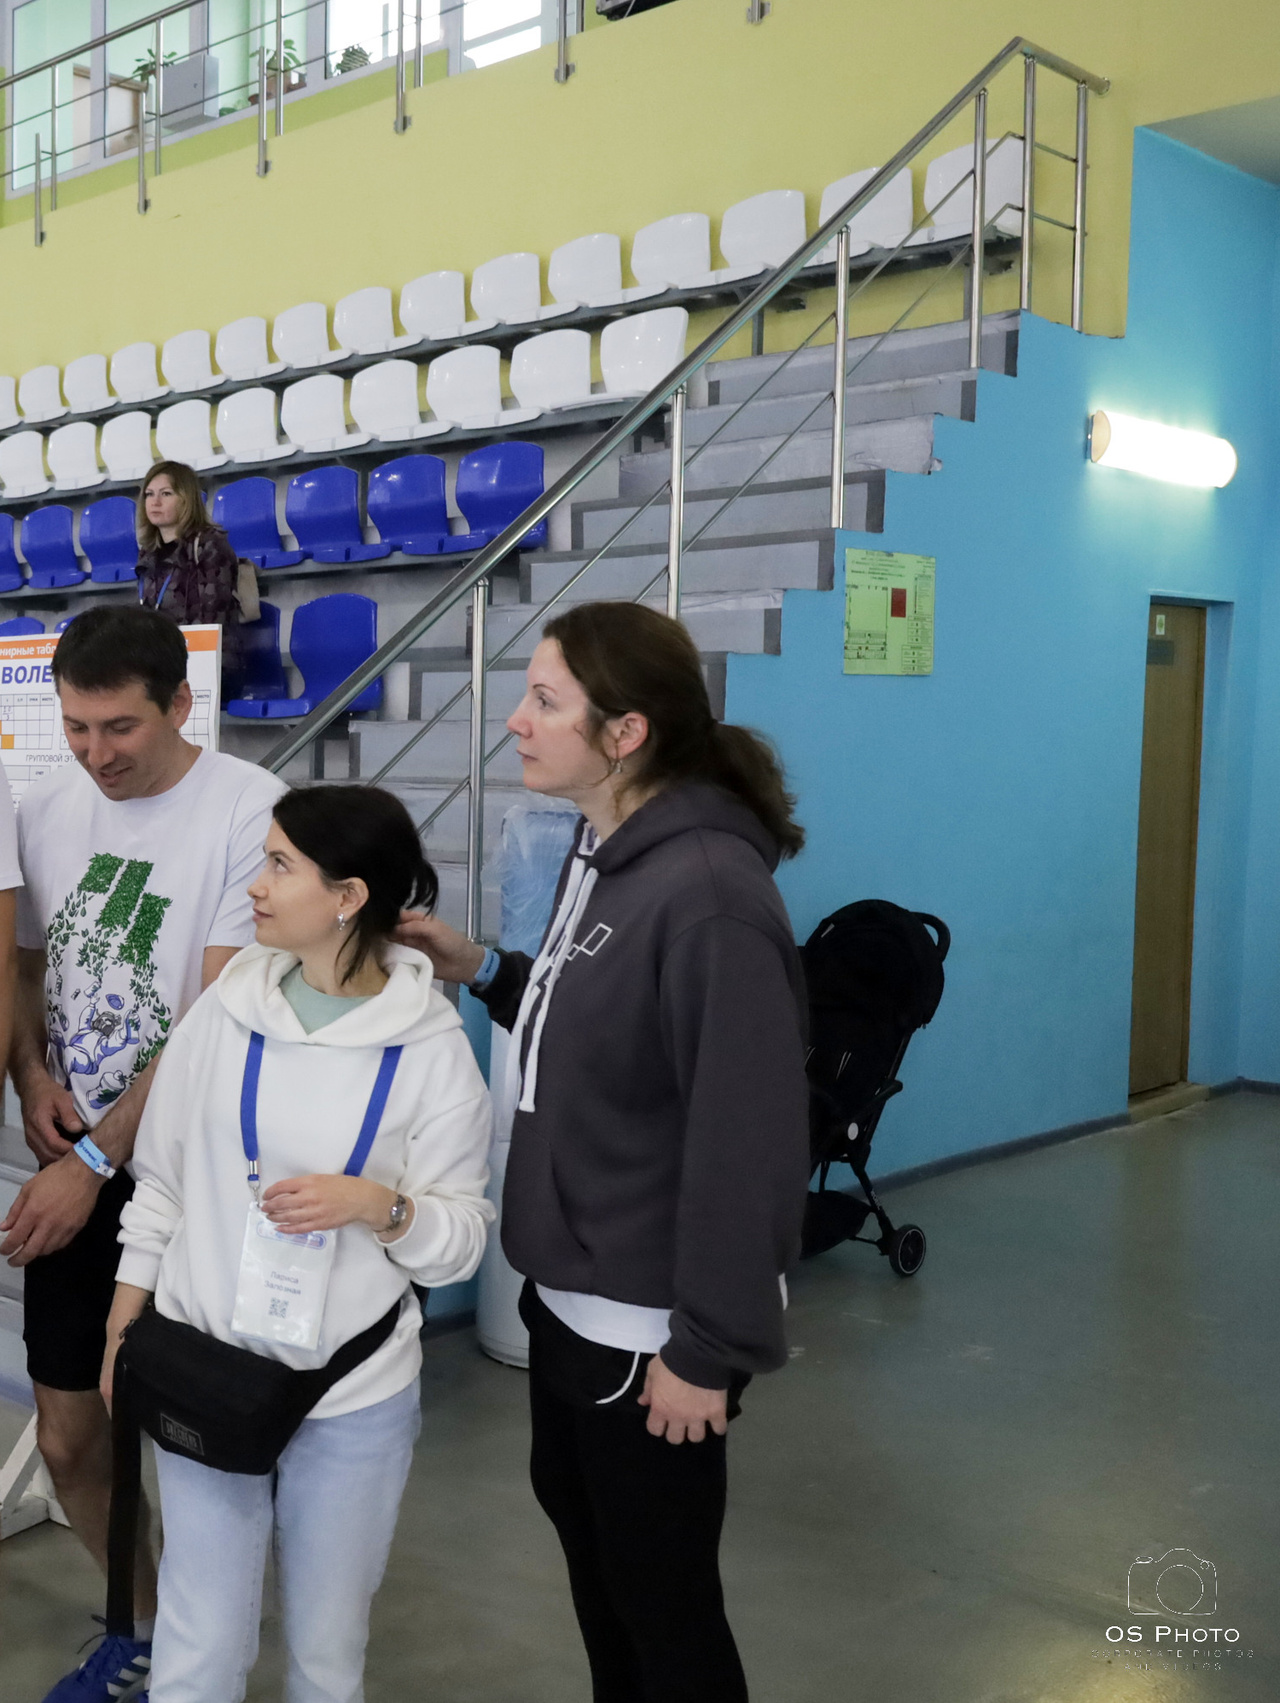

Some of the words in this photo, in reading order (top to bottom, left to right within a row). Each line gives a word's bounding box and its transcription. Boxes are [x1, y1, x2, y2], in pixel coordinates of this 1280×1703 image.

[36, 643, 57, 655] табл
[1, 665, 53, 684] ВОЛЕ
[26, 754, 63, 763] ГРУППОВОЙ
